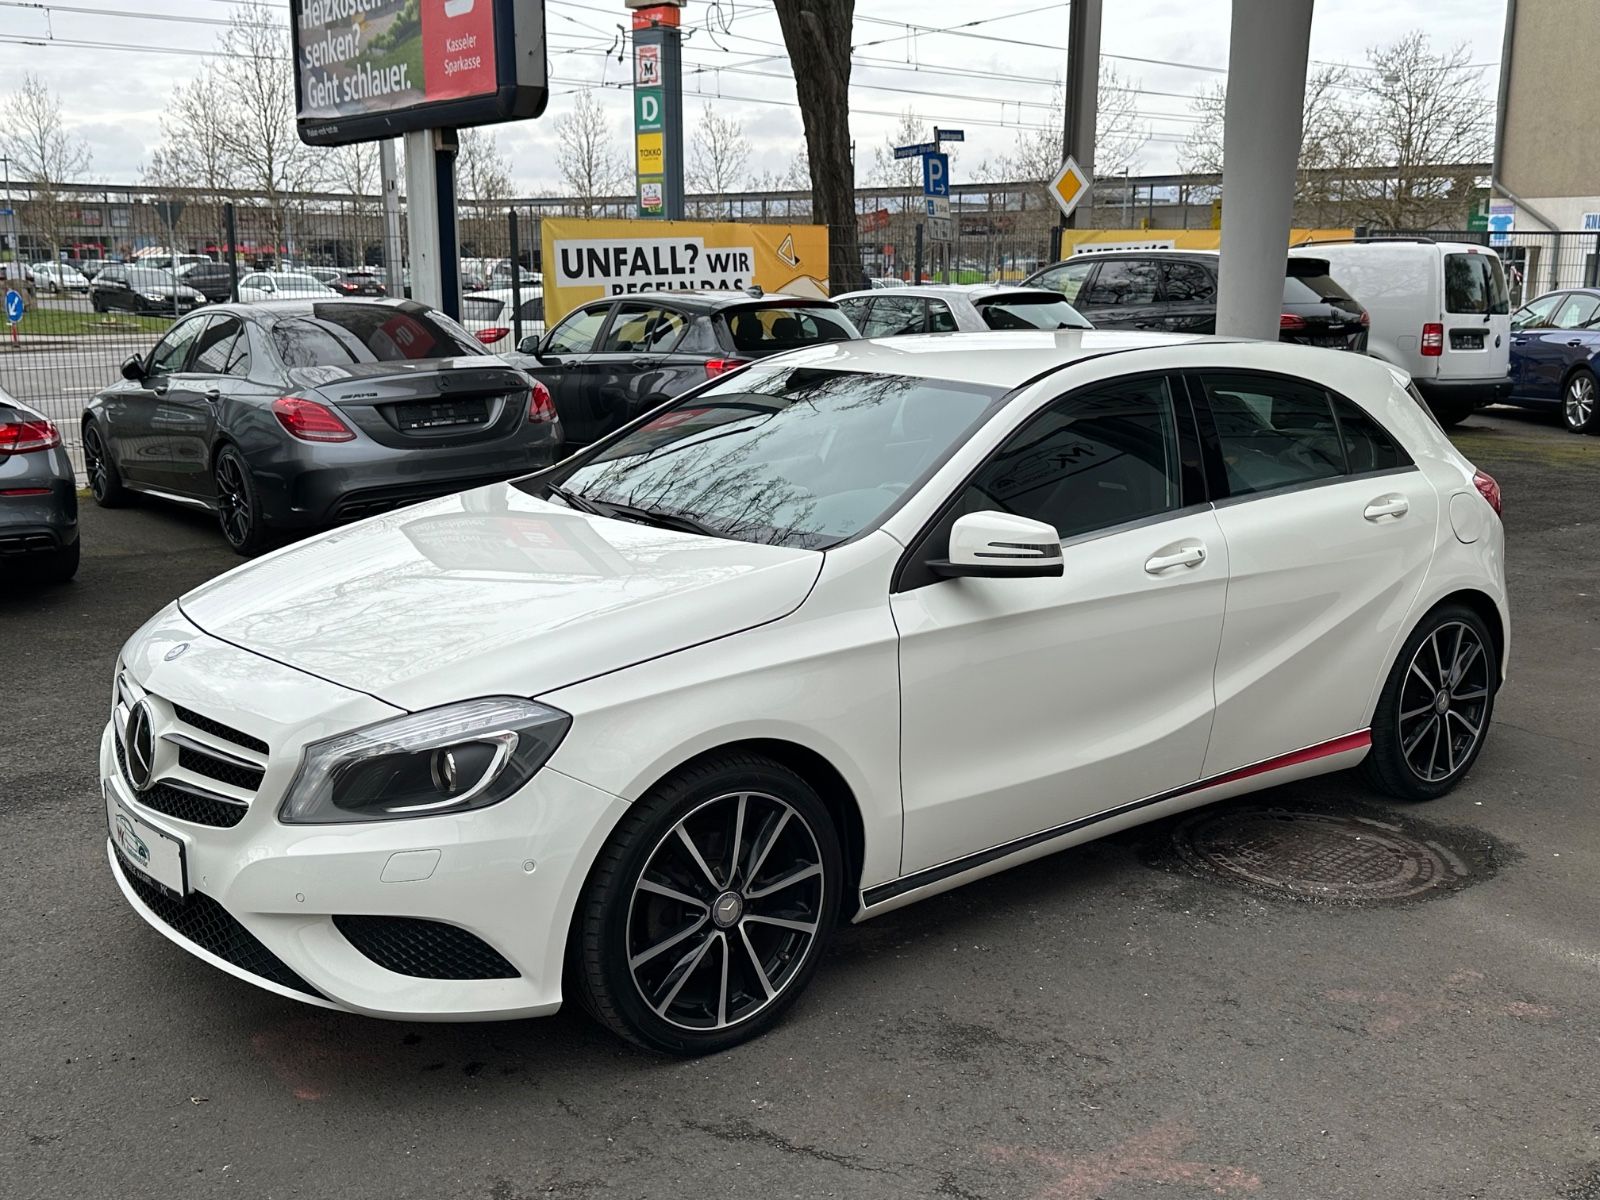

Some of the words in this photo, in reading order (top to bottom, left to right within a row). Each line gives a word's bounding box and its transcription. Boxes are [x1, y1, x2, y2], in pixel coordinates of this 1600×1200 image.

[305, 23, 360, 69] senken?
[446, 32, 477, 53] Kasseler
[444, 56, 481, 77] Sparkasse
[643, 61, 654, 76] M
[307, 71, 340, 108] Geht
[343, 61, 411, 102] schlauer.
[641, 96, 659, 122] D
[928, 158, 943, 192] P
[561, 243, 699, 279] UNFALL?
[706, 252, 750, 273] WIR
